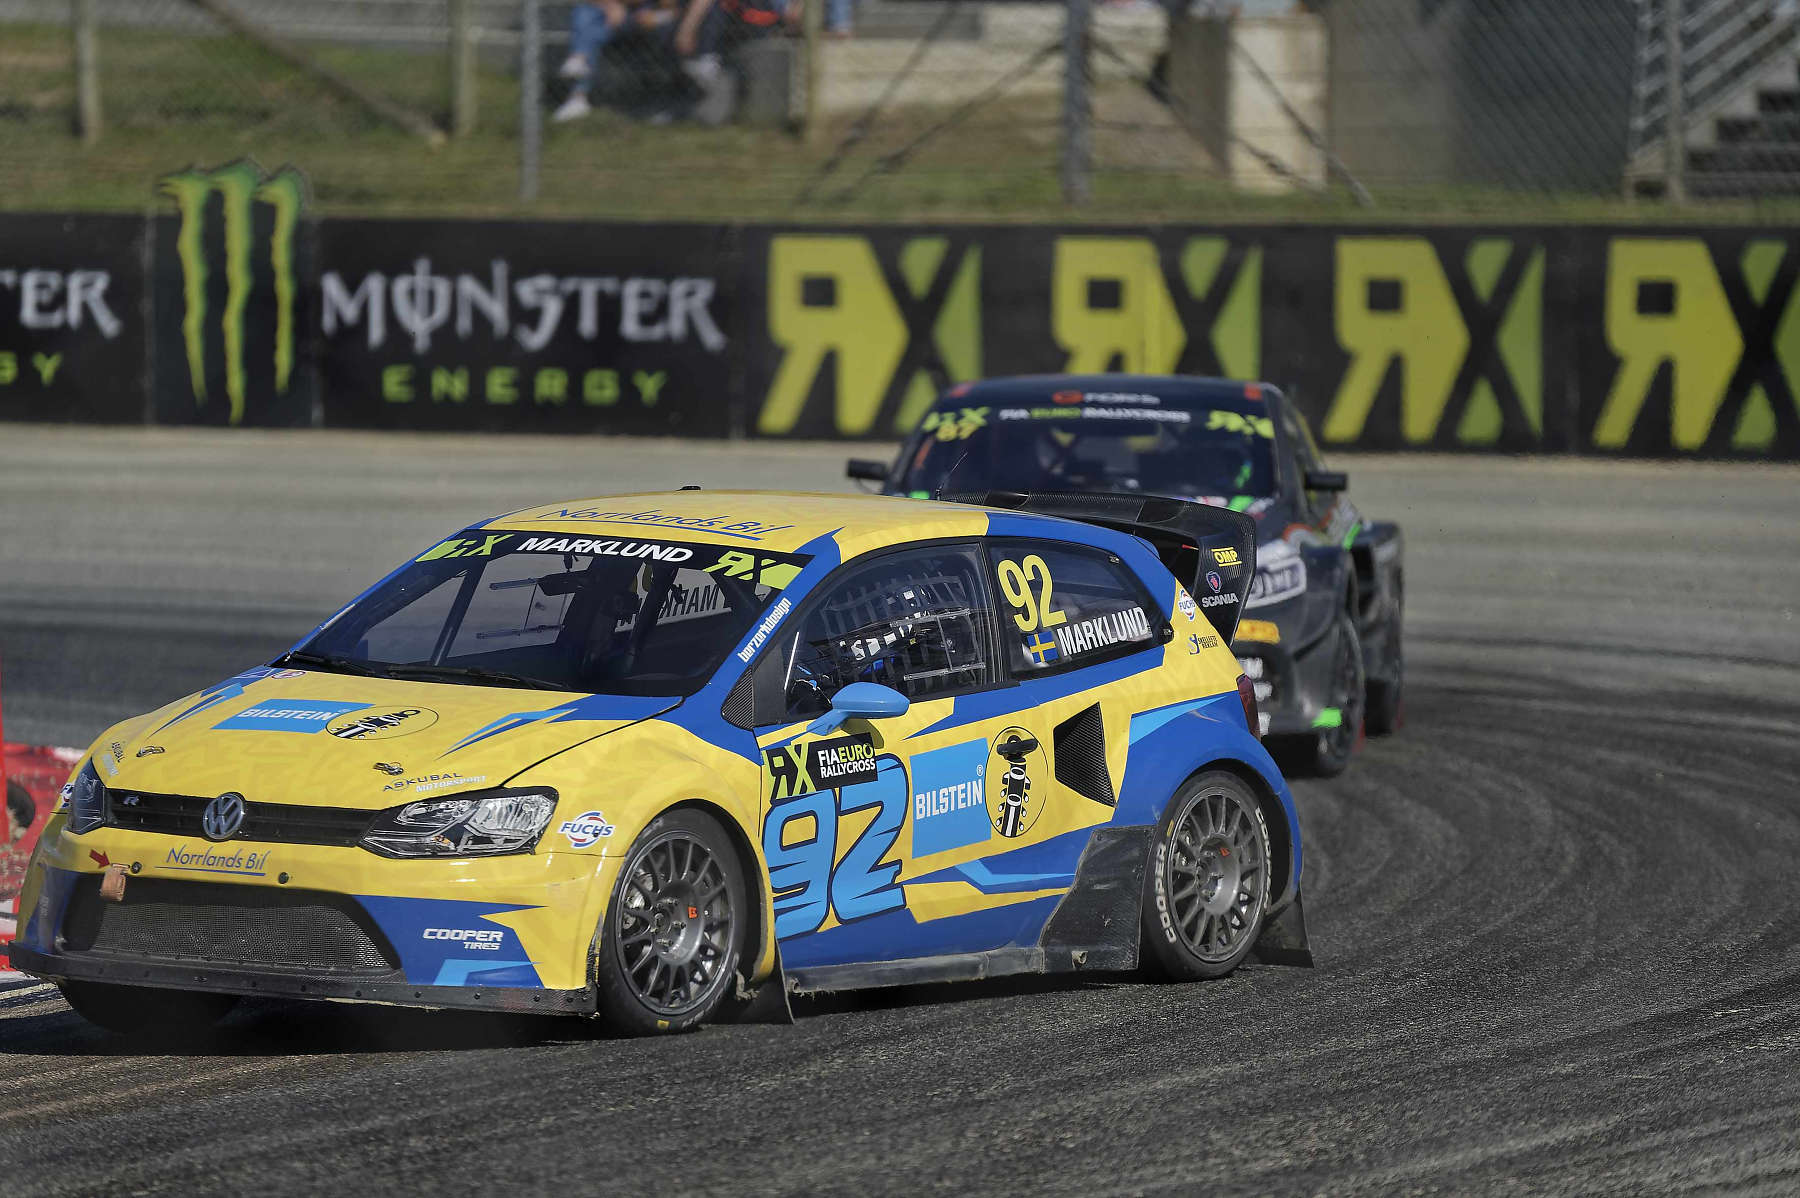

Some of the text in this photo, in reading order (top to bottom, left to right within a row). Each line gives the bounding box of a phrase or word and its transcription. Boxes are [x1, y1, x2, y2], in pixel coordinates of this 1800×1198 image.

[0, 268, 122, 338] ER
[321, 257, 726, 353] MONSTER
[382, 363, 667, 406] ENERGY
[536, 507, 796, 535] Norrlands Bil
[517, 537, 693, 562] MARKLUND
[1214, 550, 1238, 563] OMP
[997, 555, 1067, 632] 92
[1201, 592, 1239, 608] SCANIA
[1057, 606, 1148, 656] MARKLUND
[238, 708, 339, 722] BILSTEIN
[820, 757, 876, 779] RALLYCROSS
[915, 779, 982, 820] BILSTEIN
[560, 821, 613, 838] FUCHS
[166, 844, 271, 870] Norrlands Bil
[763, 752, 910, 942] 92
[1155, 843, 1177, 944] COOPER
[423, 928, 504, 943] COOPER
[463, 942, 500, 951] TIRES
